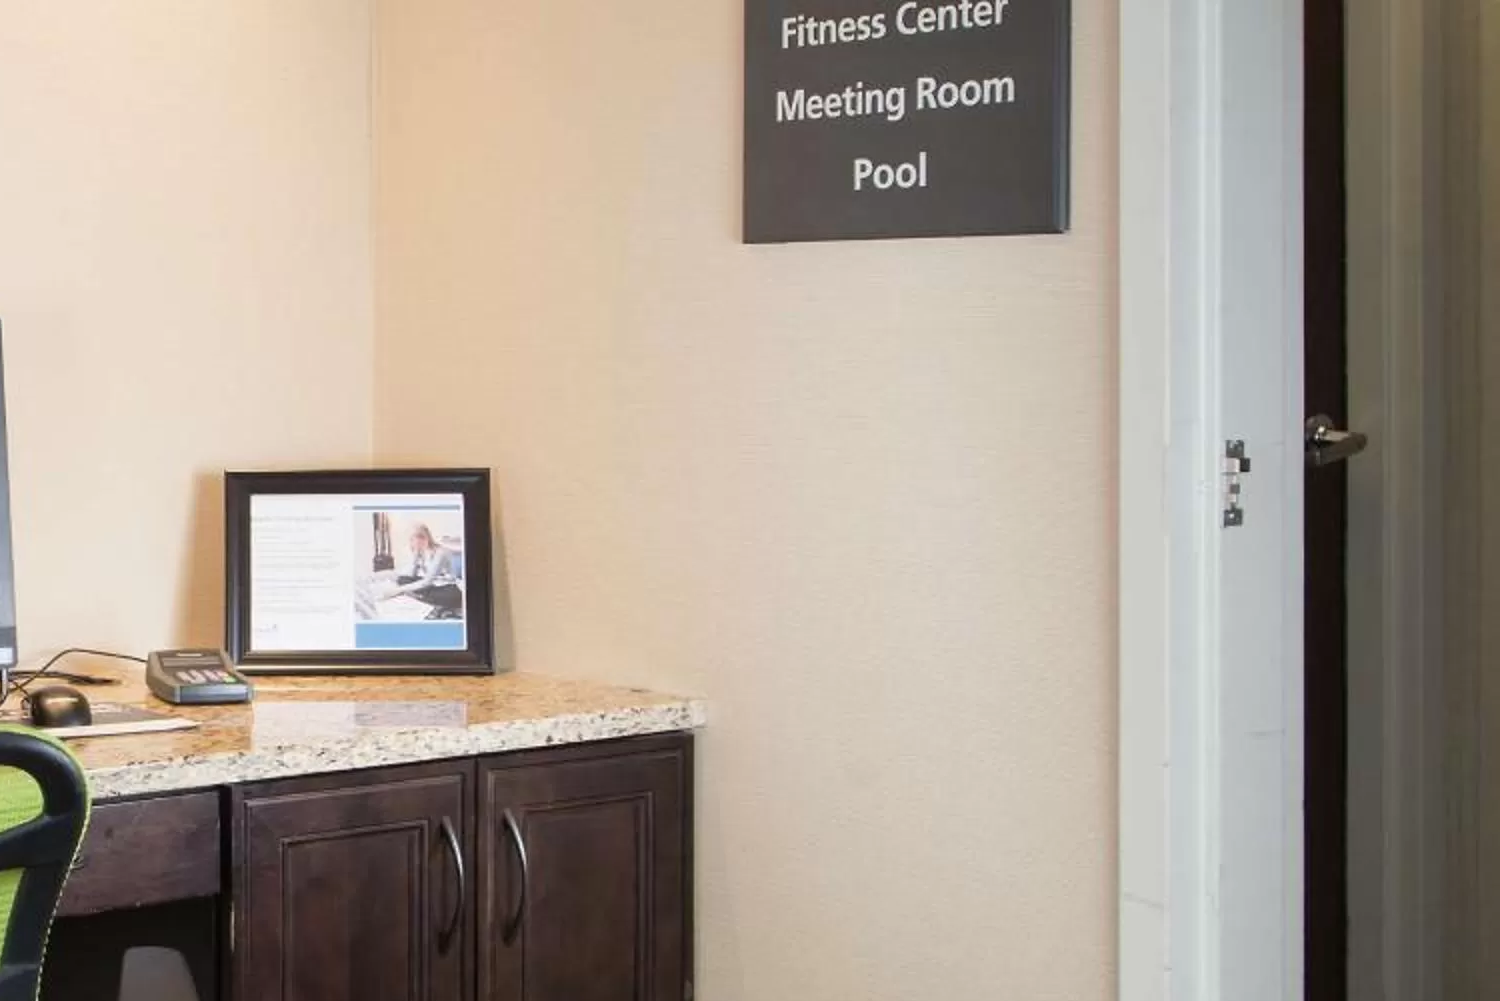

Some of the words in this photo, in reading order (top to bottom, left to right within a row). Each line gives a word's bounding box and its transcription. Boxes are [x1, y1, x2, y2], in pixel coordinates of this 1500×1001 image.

[781, 13, 887, 49] Fitness
[896, 0, 1008, 35] Center
[776, 82, 905, 122] Meeting
[916, 76, 1015, 110] Room
[853, 152, 927, 191] Pool
